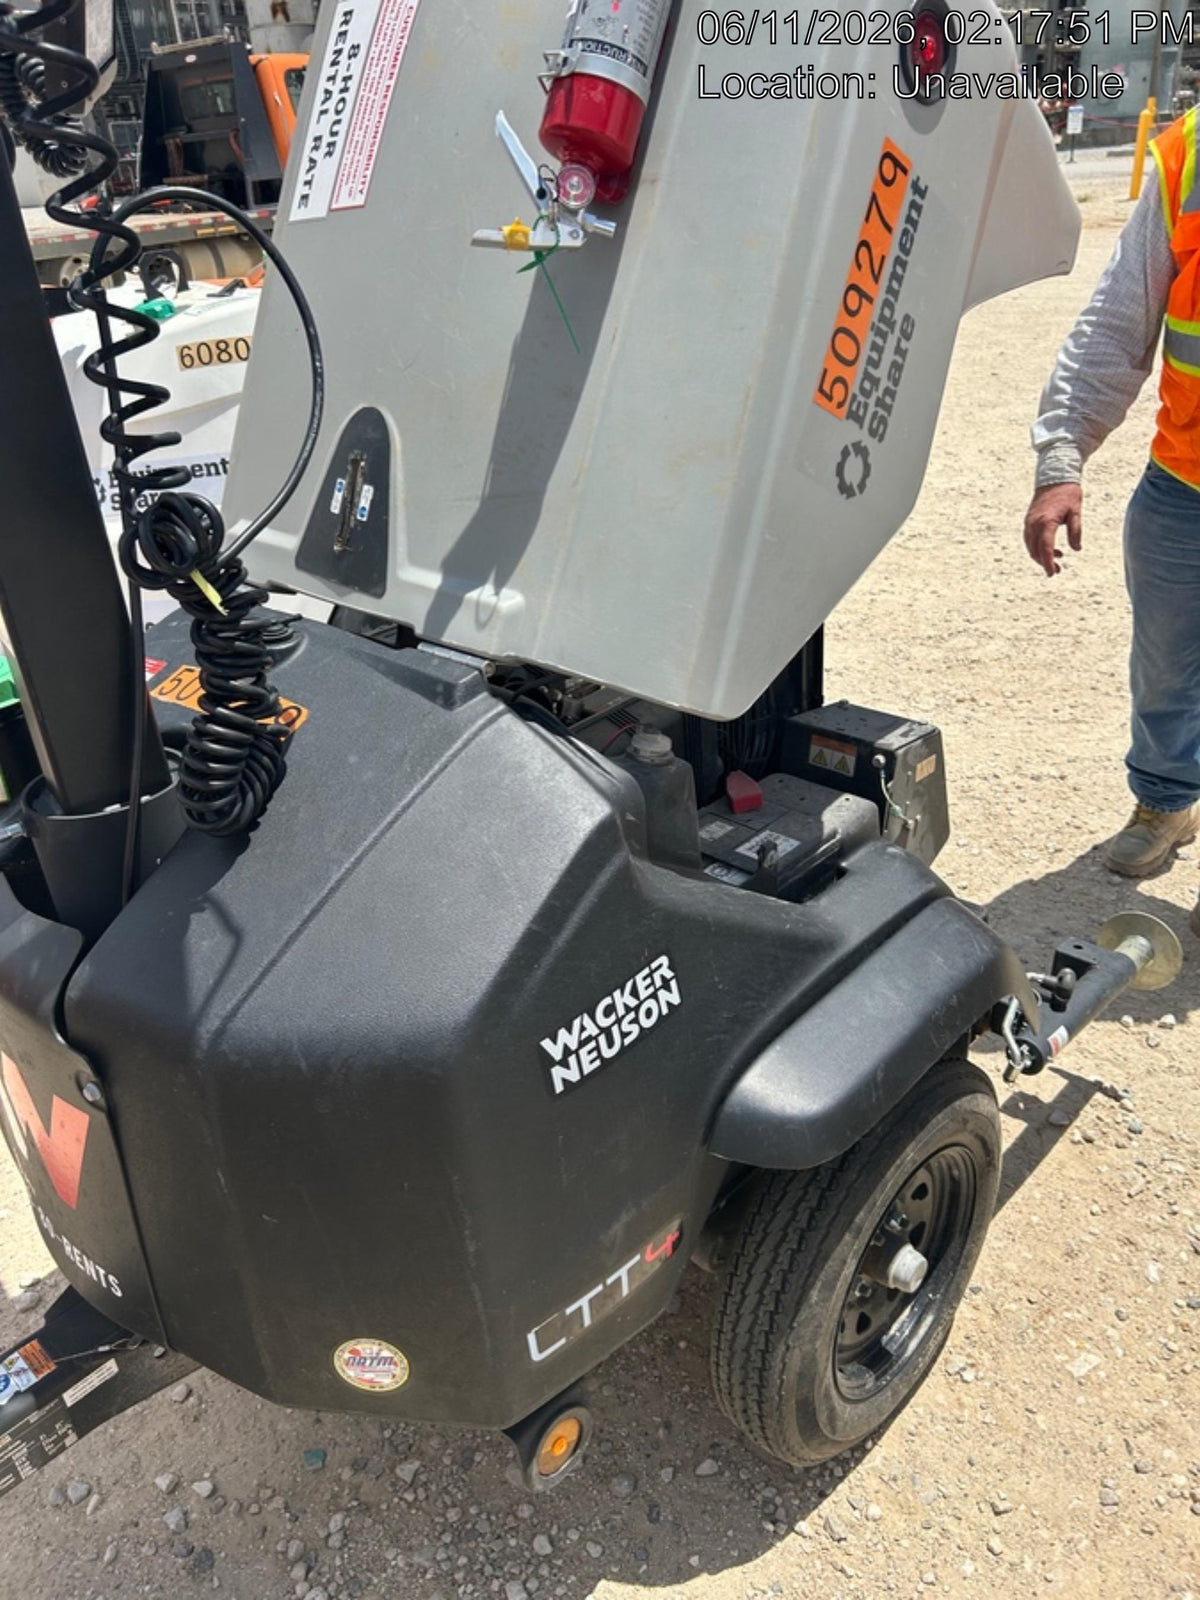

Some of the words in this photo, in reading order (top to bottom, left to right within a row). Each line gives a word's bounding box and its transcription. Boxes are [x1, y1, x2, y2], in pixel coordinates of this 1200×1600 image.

[316, 9, 354, 124] RENTAL
[389, 6, 414, 81] CUSTOMER
[323, 43, 361, 160] 8-HOUR
[358, 84, 391, 196] RESPONSIBILITY
[297, 134, 323, 210] RATE
[817, 150, 909, 409] 509279
[845, 175, 929, 430] Equipment
[179, 337, 251, 369] 6080
[867, 313, 916, 443] Share
[539, 954, 675, 1062] WACKER
[550, 978, 682, 1094] NEUSON
